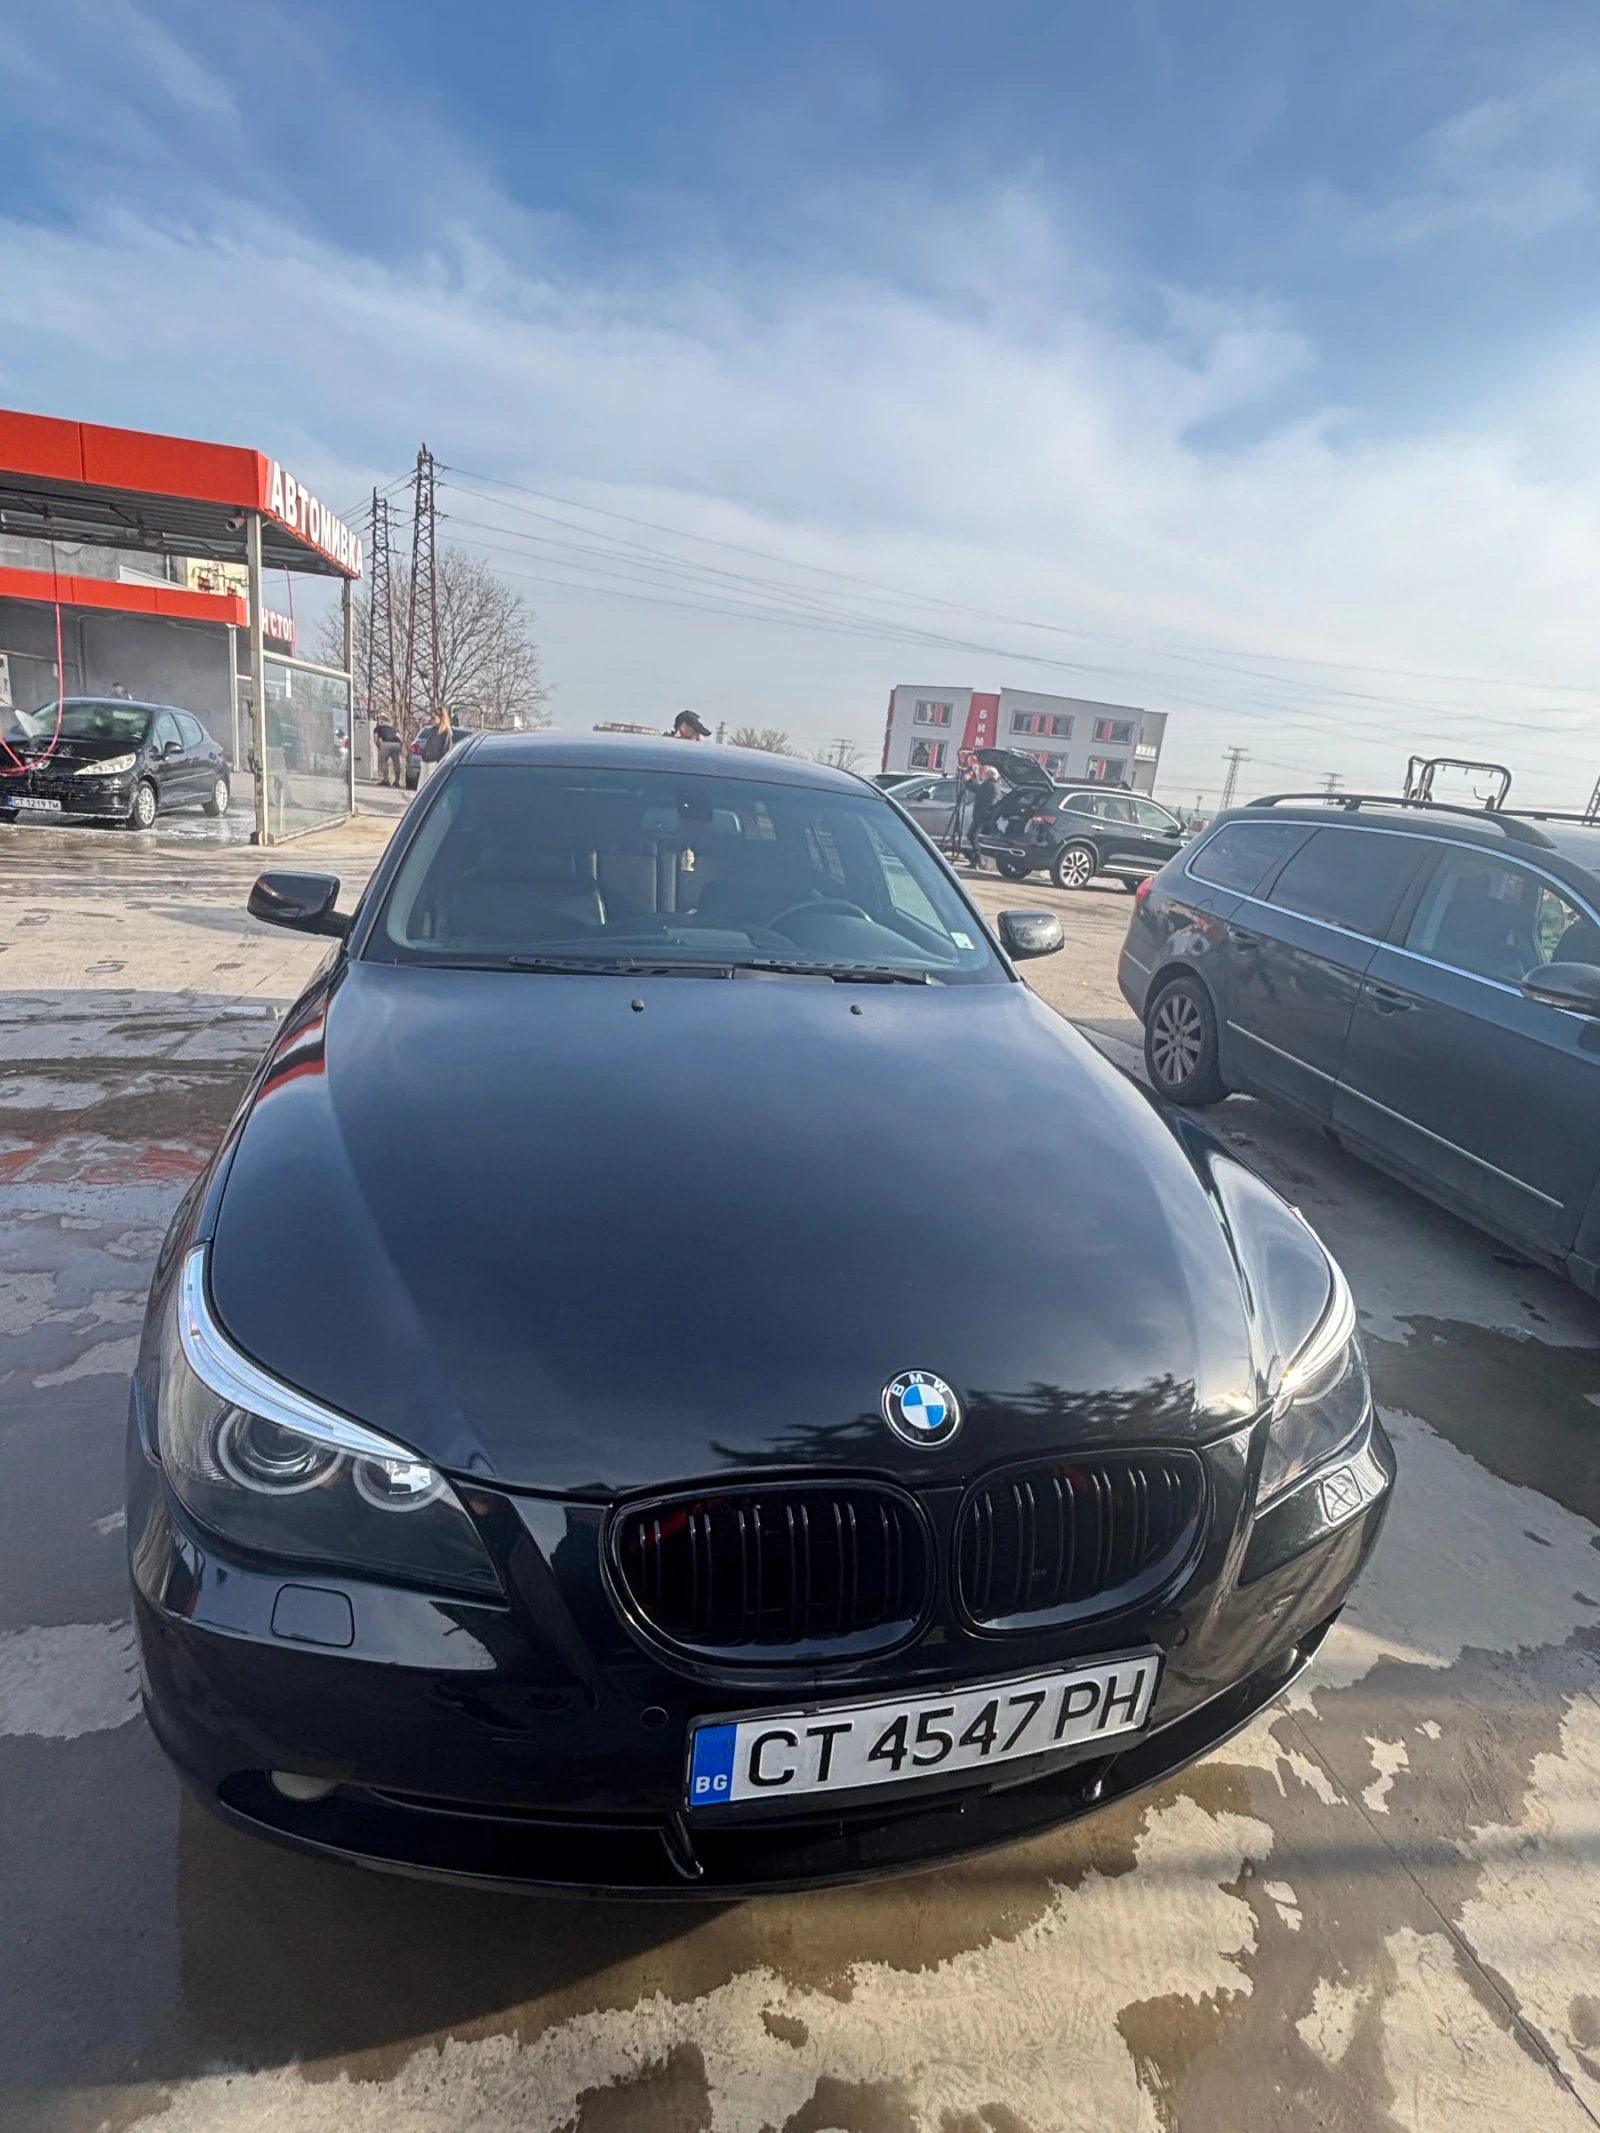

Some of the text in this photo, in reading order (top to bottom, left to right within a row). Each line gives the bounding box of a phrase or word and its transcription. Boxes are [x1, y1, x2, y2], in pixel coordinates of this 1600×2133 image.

[271, 461, 363, 578] АВТОМИВКА
[891, 1373, 949, 1397] BMW
[695, 1669, 1146, 1794] BG CT 4547 PH
